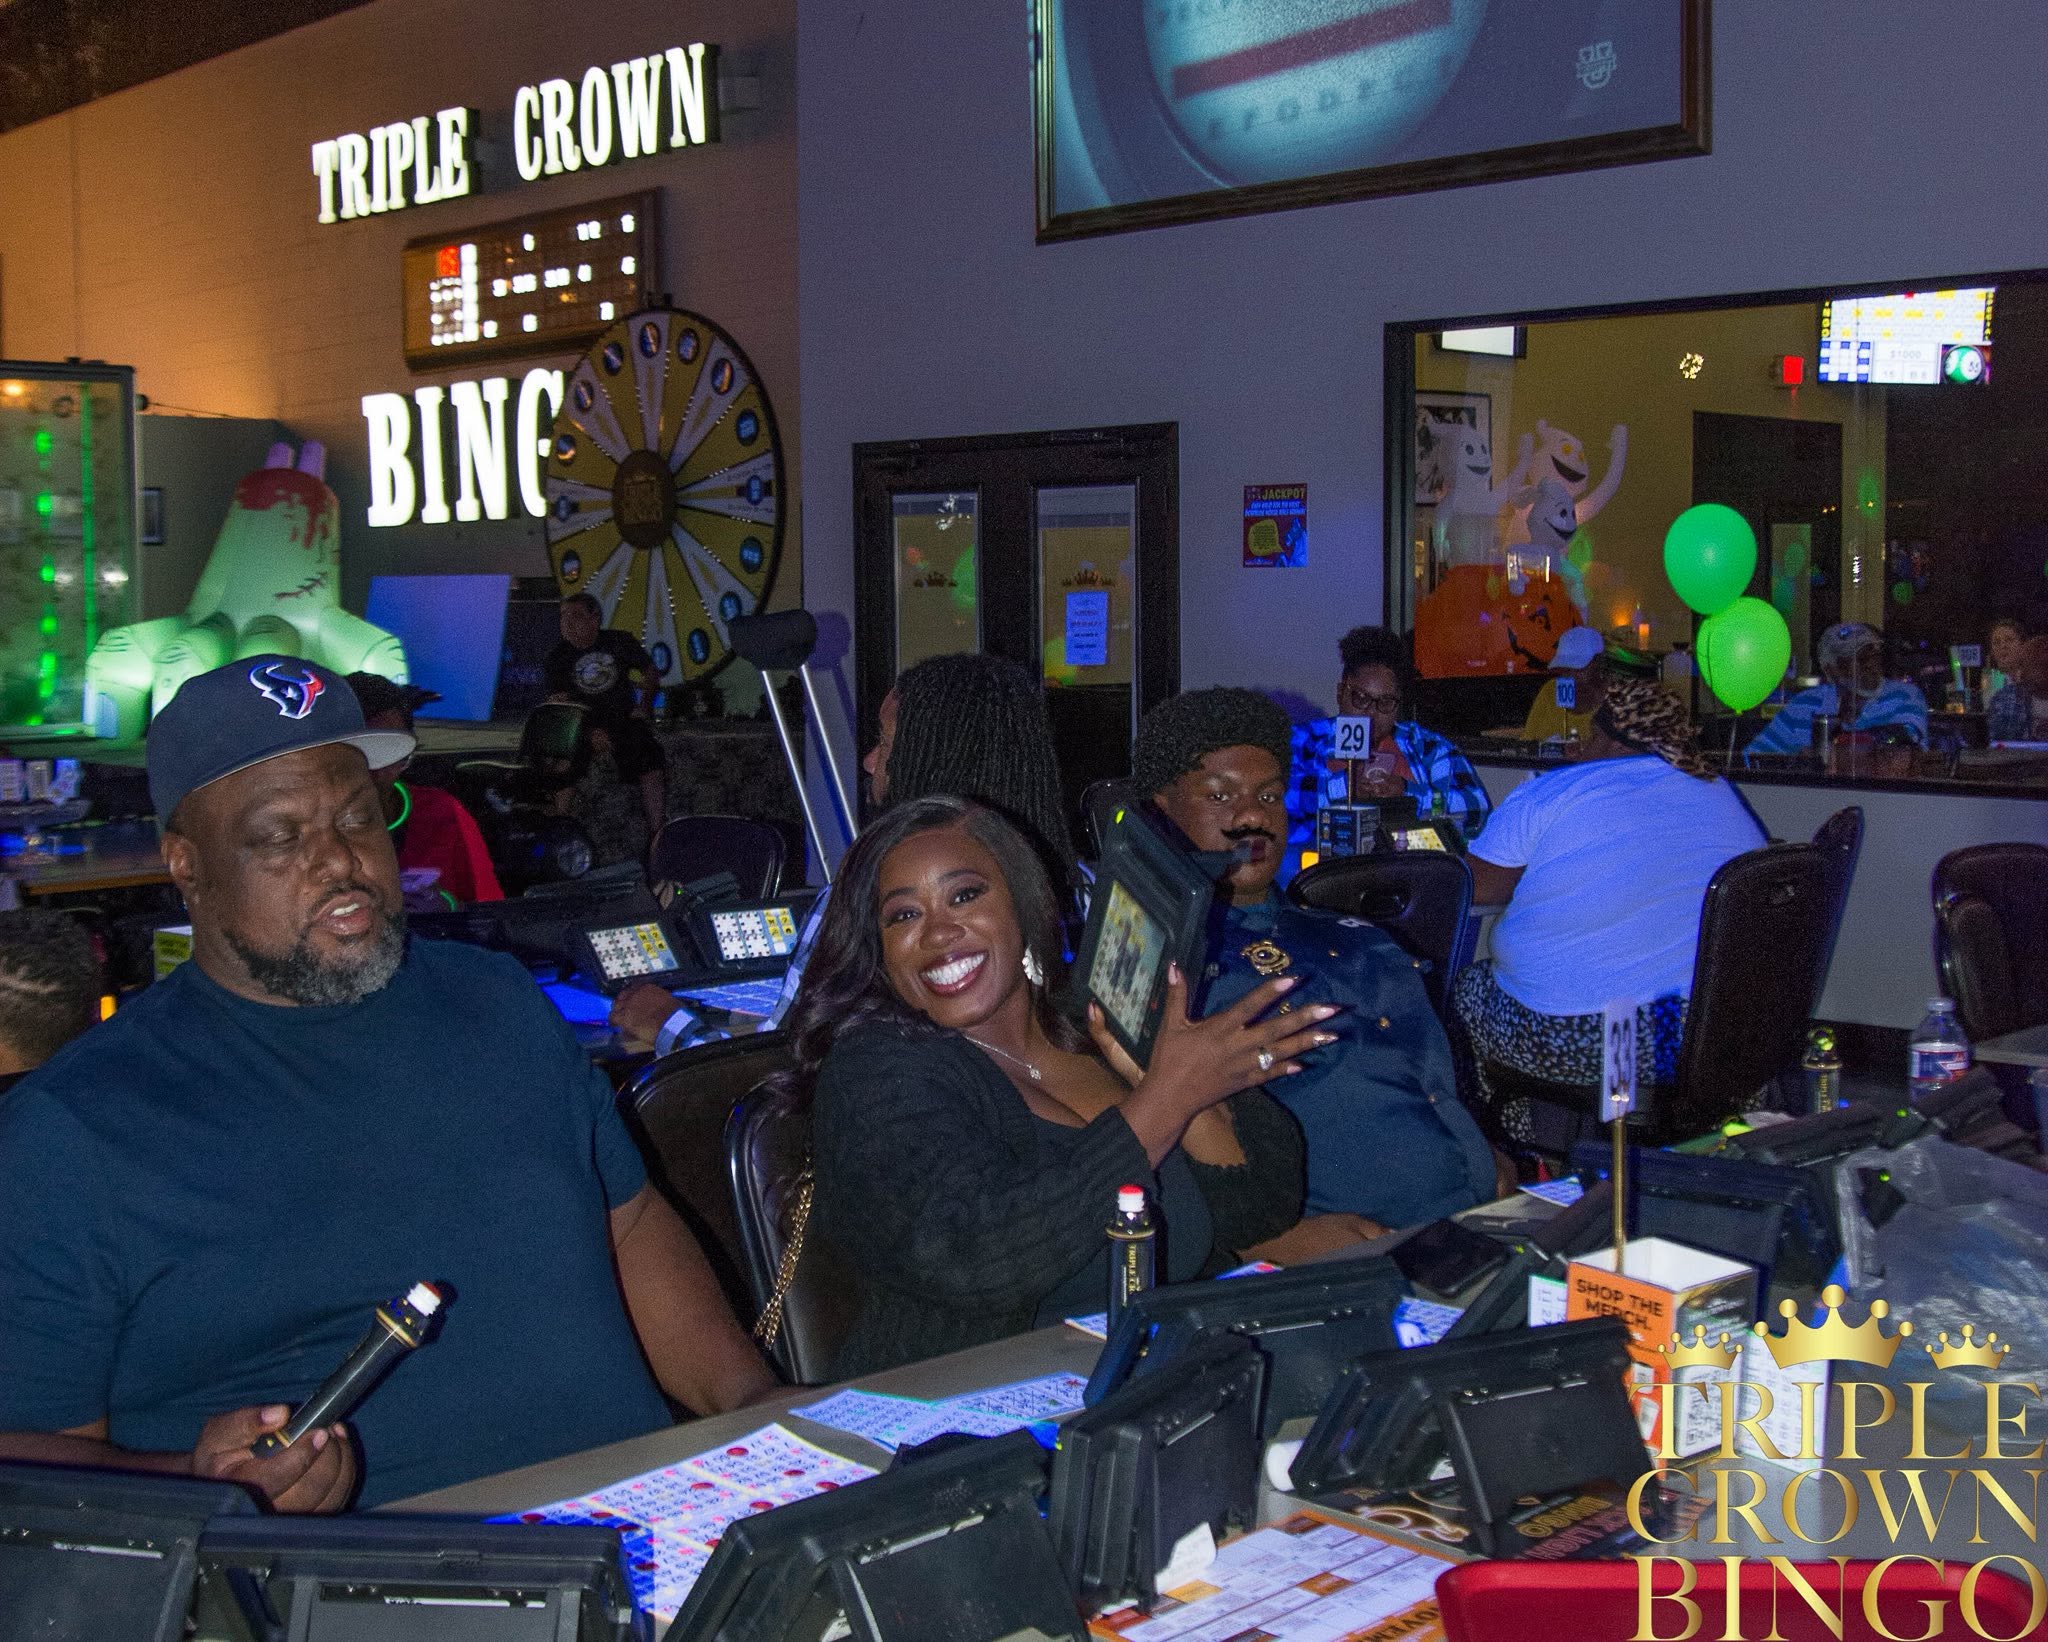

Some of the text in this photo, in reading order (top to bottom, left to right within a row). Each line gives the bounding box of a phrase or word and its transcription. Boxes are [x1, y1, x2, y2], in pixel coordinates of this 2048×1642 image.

[311, 42, 706, 225] TRIPLE CROWN
[361, 367, 564, 528] BING
[1263, 487, 1305, 500] JACKPOT
[1340, 724, 1365, 751] 29
[1577, 1279, 1663, 1318] SHOP THE
